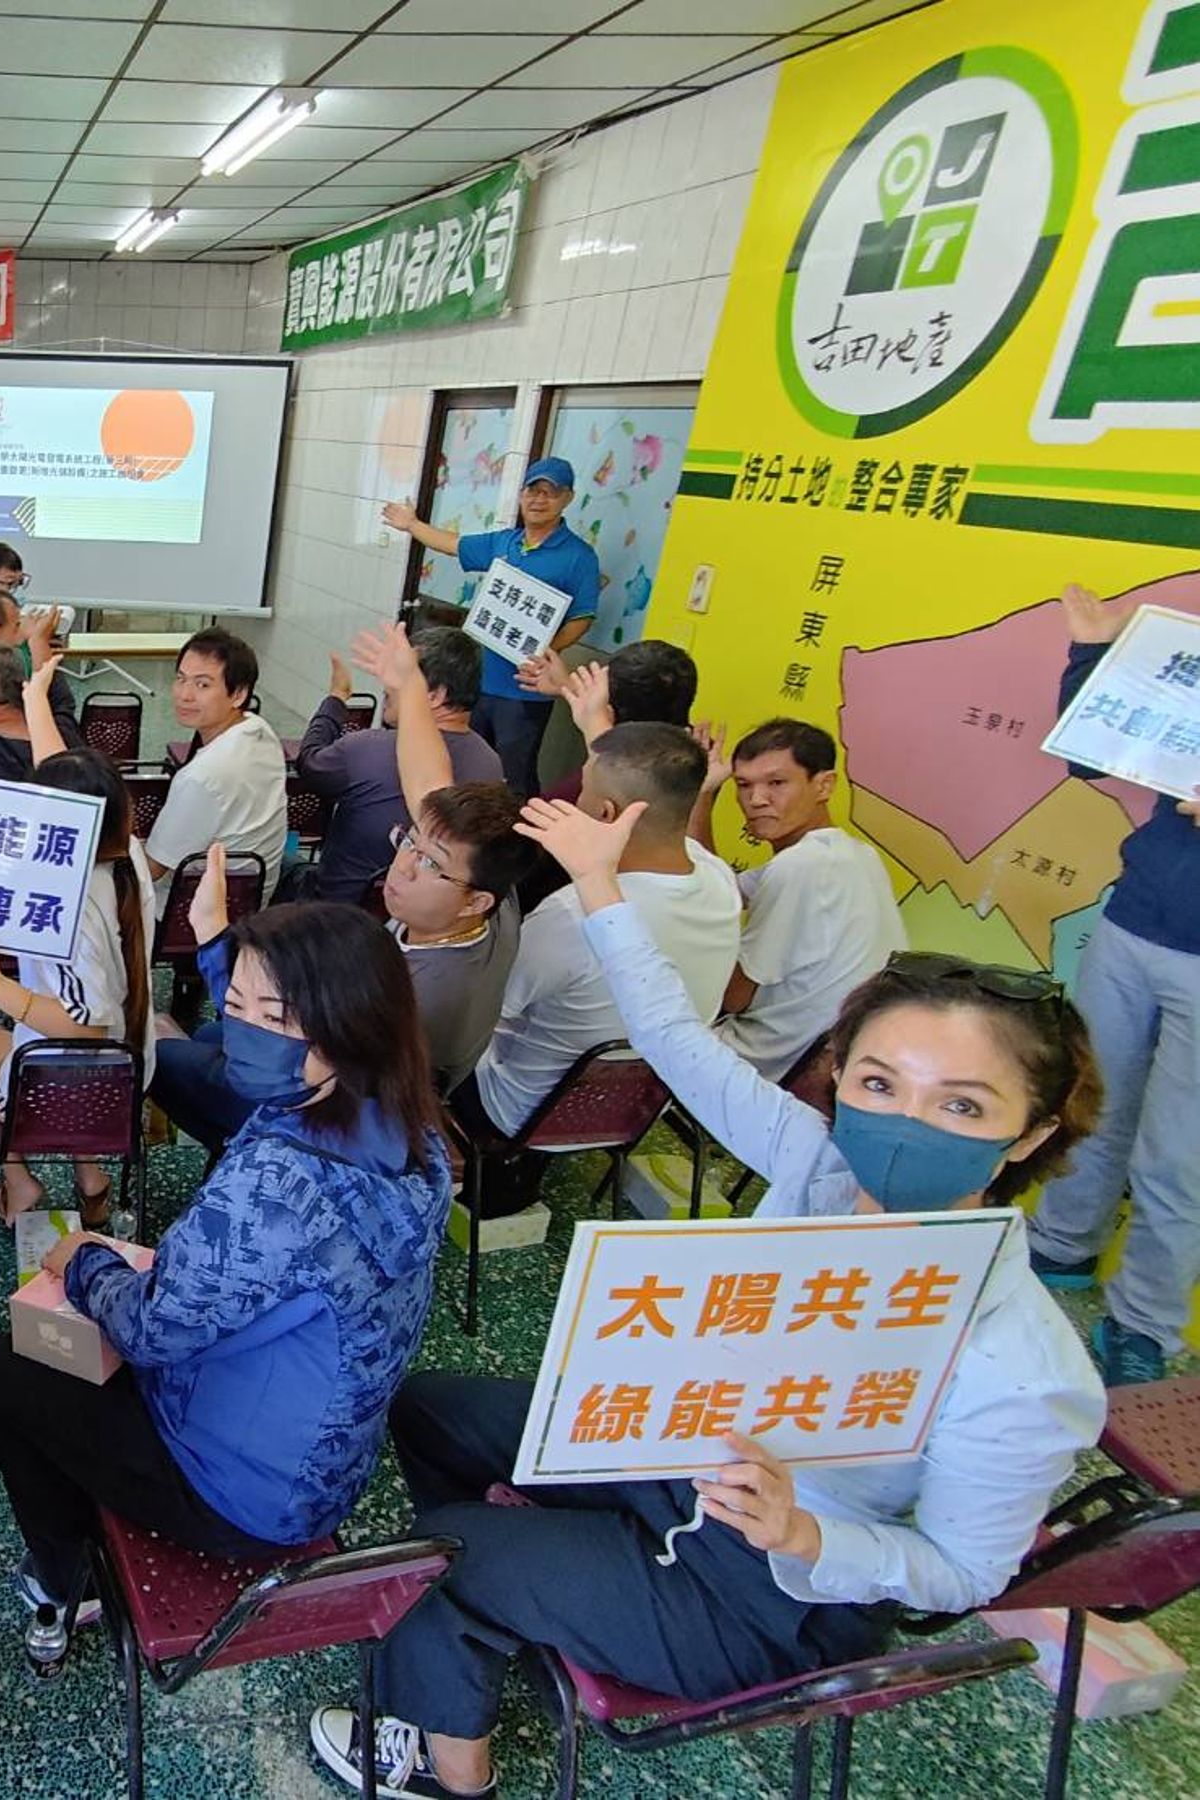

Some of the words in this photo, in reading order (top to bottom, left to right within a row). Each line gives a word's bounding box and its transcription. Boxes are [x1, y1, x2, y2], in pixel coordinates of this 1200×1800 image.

[488, 578, 557, 627] 支持光電
[779, 555, 844, 702] 屏東縣
[596, 1264, 960, 1341] 太陽共生
[568, 1367, 922, 1445] 綠能共榮
